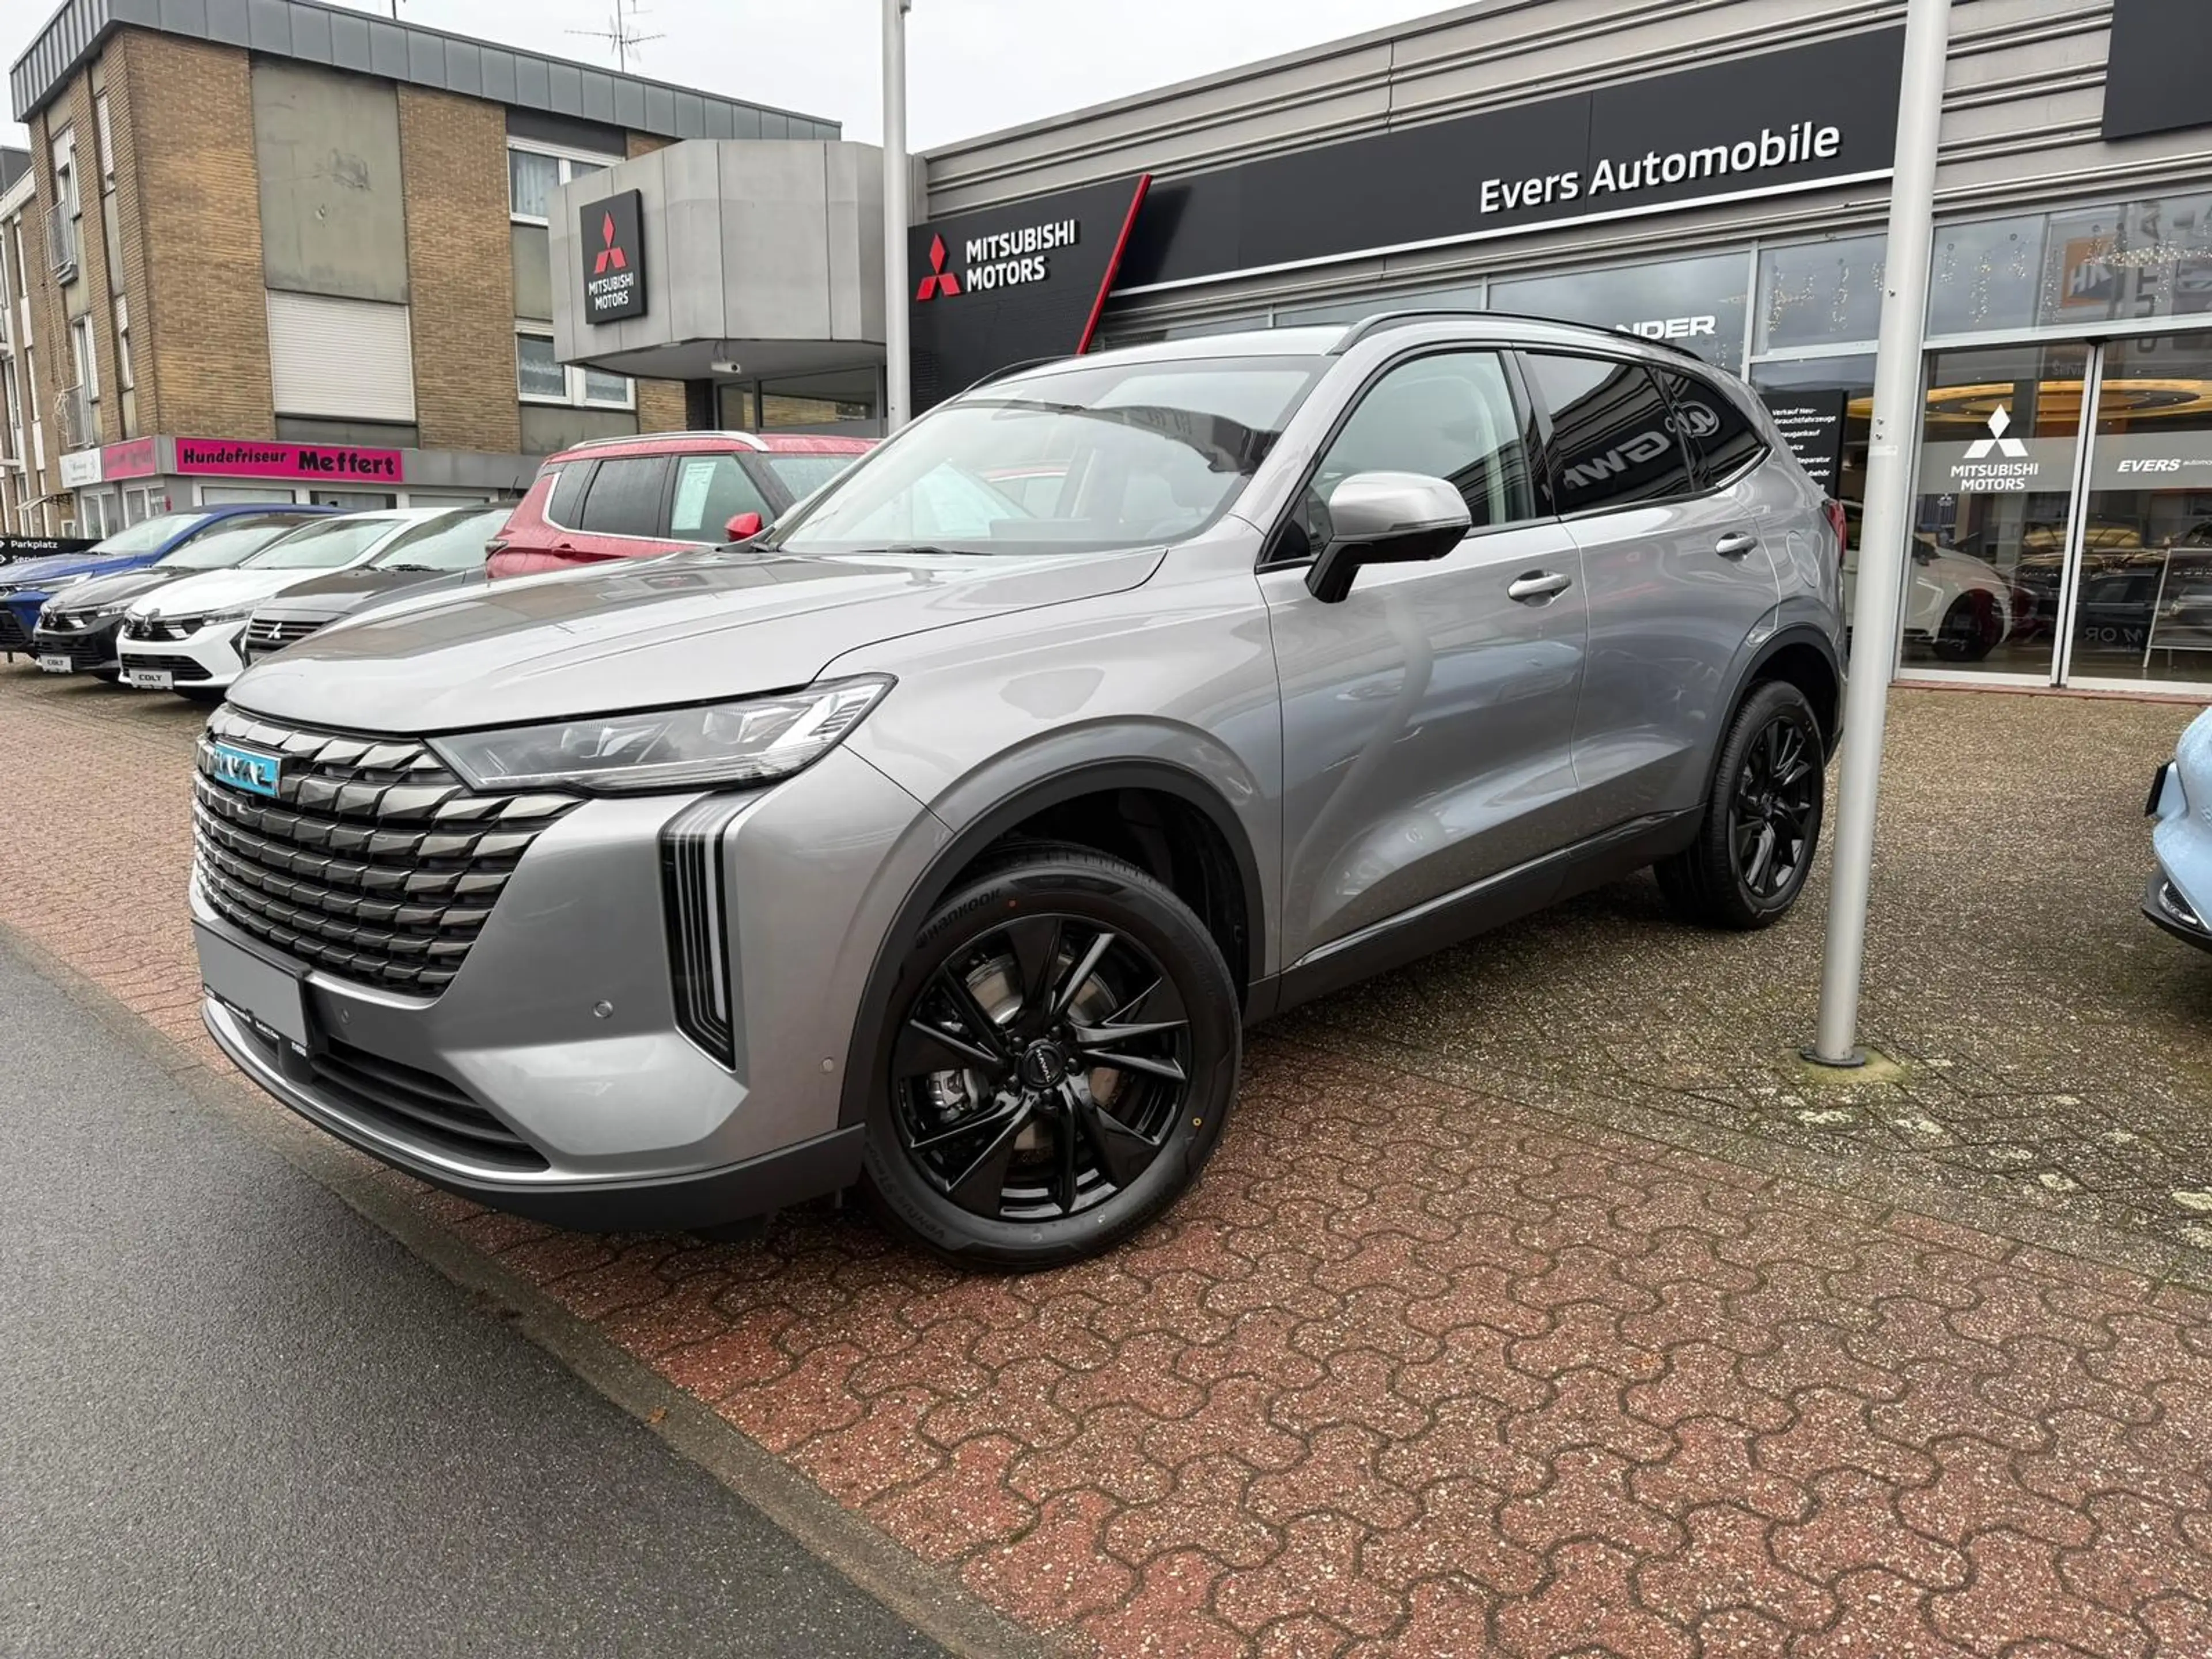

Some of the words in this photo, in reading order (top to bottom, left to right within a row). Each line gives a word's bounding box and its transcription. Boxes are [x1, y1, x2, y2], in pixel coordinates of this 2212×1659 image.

[1480, 171, 1578, 214] Evers
[1588, 121, 1840, 196] Automobile
[966, 219, 1075, 264] MITSUBISHI
[589, 272, 634, 296] MITSUBISHI
[966, 256, 1045, 293] MOTORS
[594, 290, 629, 310] MOTORS
[183, 448, 287, 464] Hundefriseur
[298, 450, 395, 475] Meffert
[1950, 463, 2039, 478] MITSUBISHI
[2117, 459, 2181, 472] EVERS
[1961, 478, 2025, 491] MOTORS
[10, 540, 58, 550] Parkplatz
